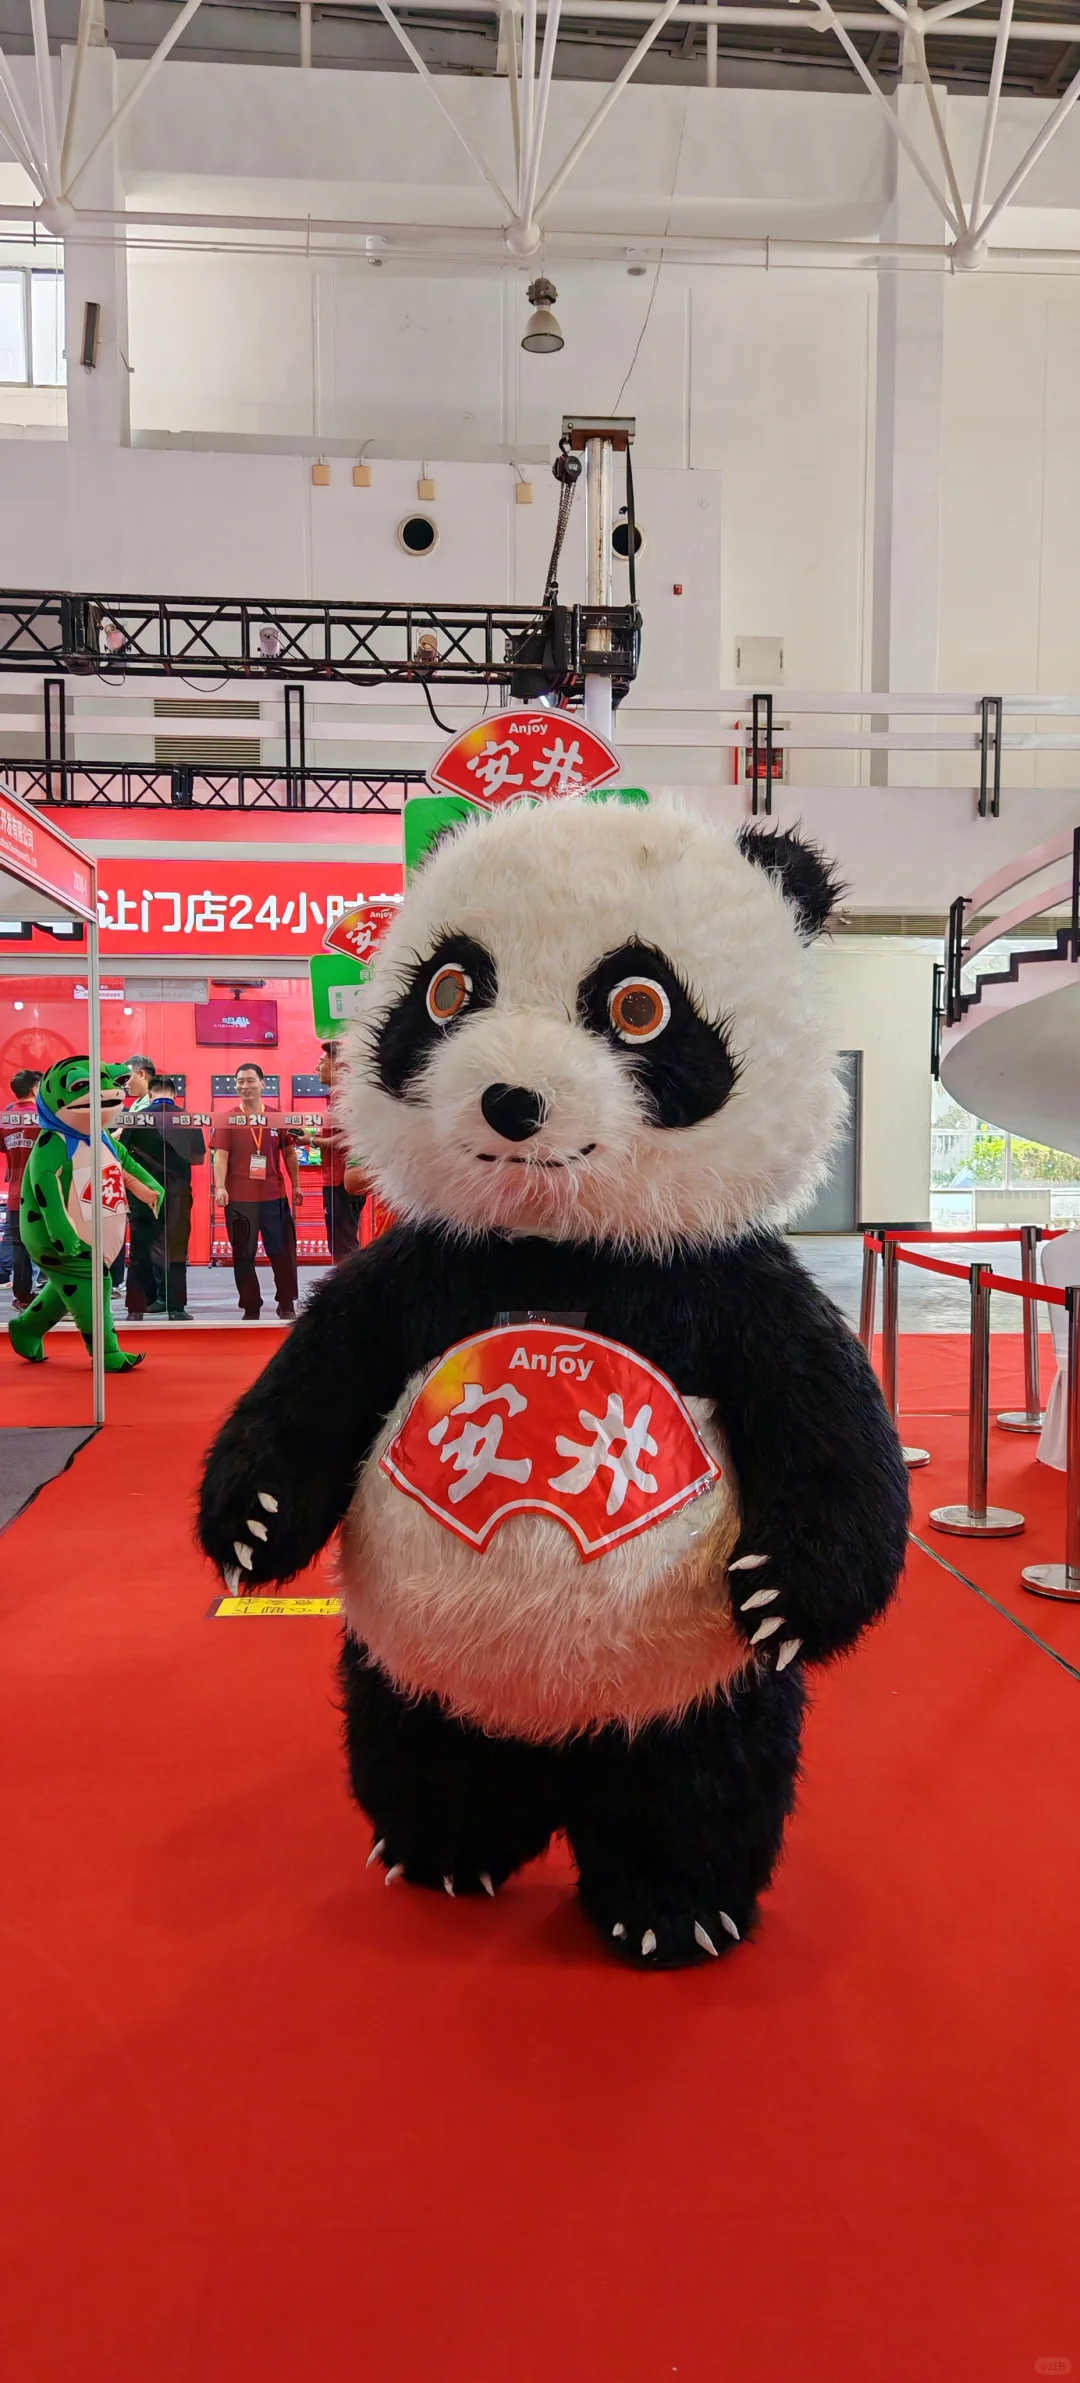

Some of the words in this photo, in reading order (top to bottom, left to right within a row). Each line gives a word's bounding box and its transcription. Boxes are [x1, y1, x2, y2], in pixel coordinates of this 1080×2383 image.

[508, 718, 549, 737] Anjoy
[466, 737, 584, 797] 安井
[369, 908, 393, 919] Anjoy
[508, 1343, 594, 1381] Anjoy
[427, 1383, 658, 1516] 安井
